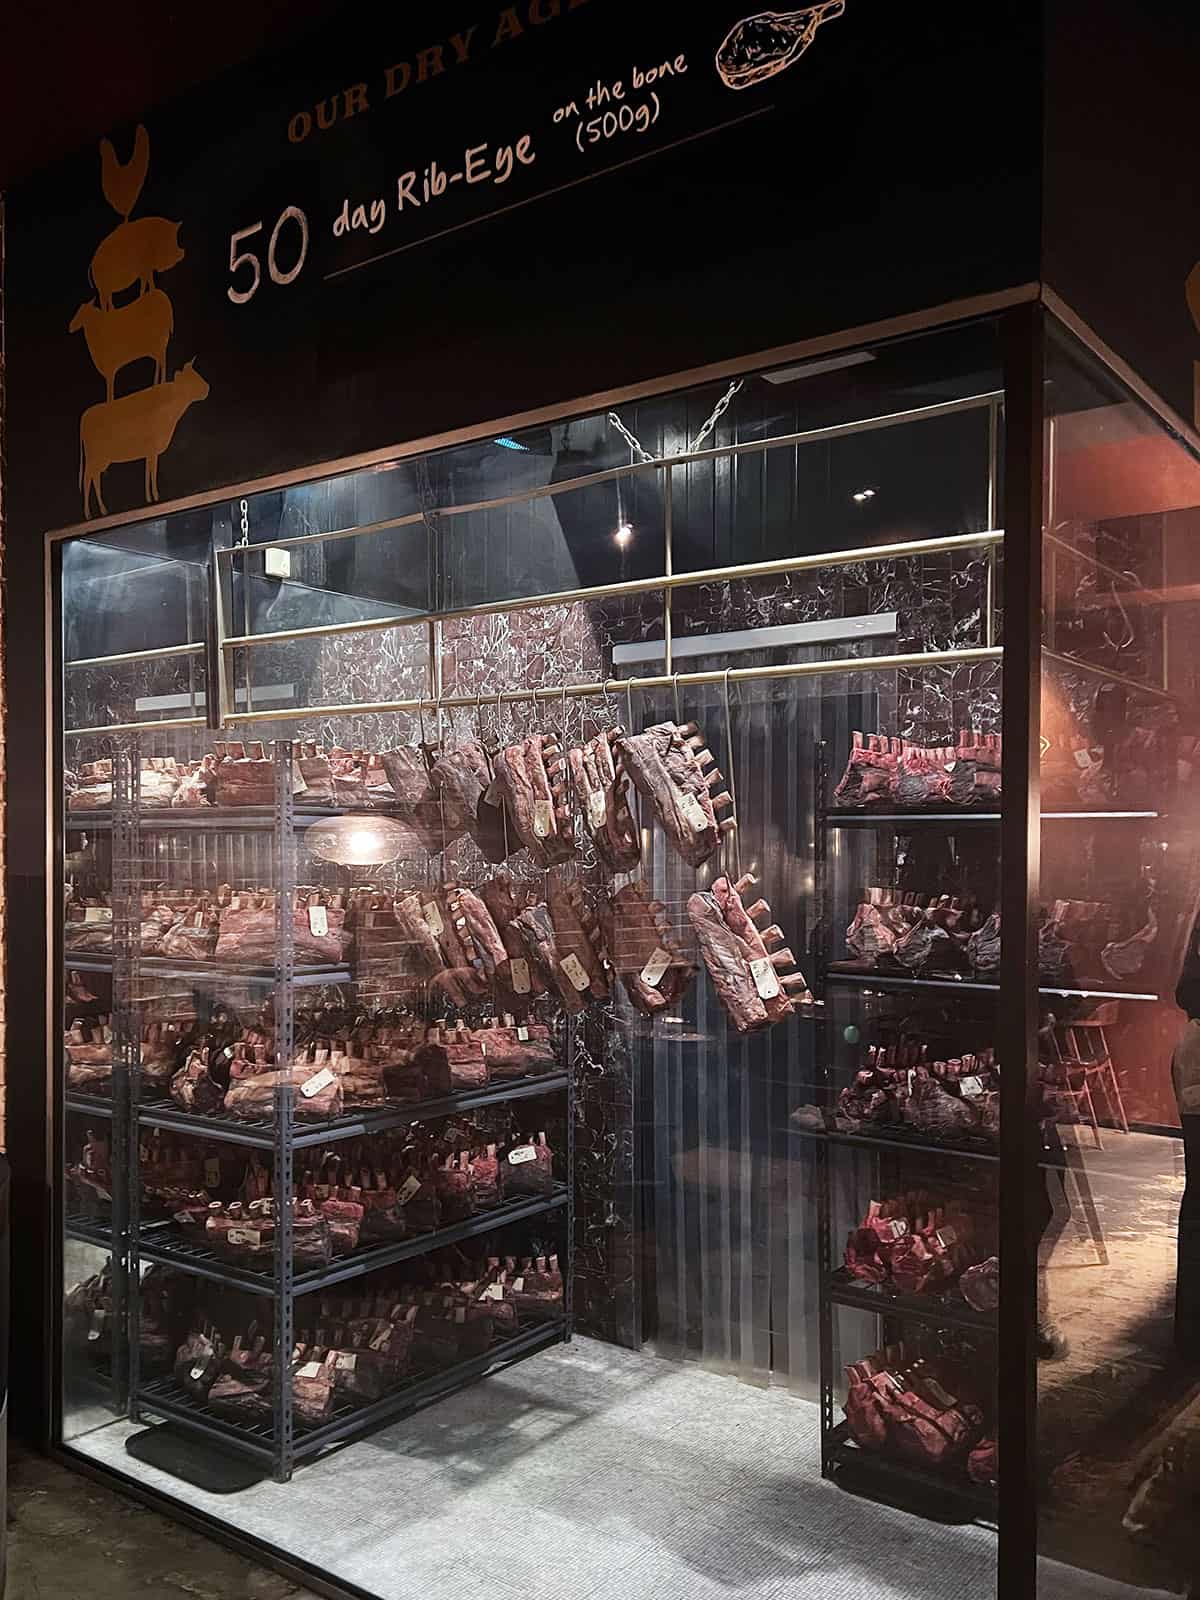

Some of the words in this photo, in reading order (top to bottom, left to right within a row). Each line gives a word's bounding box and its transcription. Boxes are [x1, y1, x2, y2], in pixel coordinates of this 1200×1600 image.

[287, 80, 371, 145] OUR
[383, 23, 478, 102] DRY
[552, 101, 581, 123] on
[585, 79, 627, 111] the
[632, 53, 689, 89] bone
[575, 91, 661, 154] (500g)
[226, 205, 310, 305] 50
[332, 198, 387, 237] day
[397, 134, 537, 211] Rib-Eye
